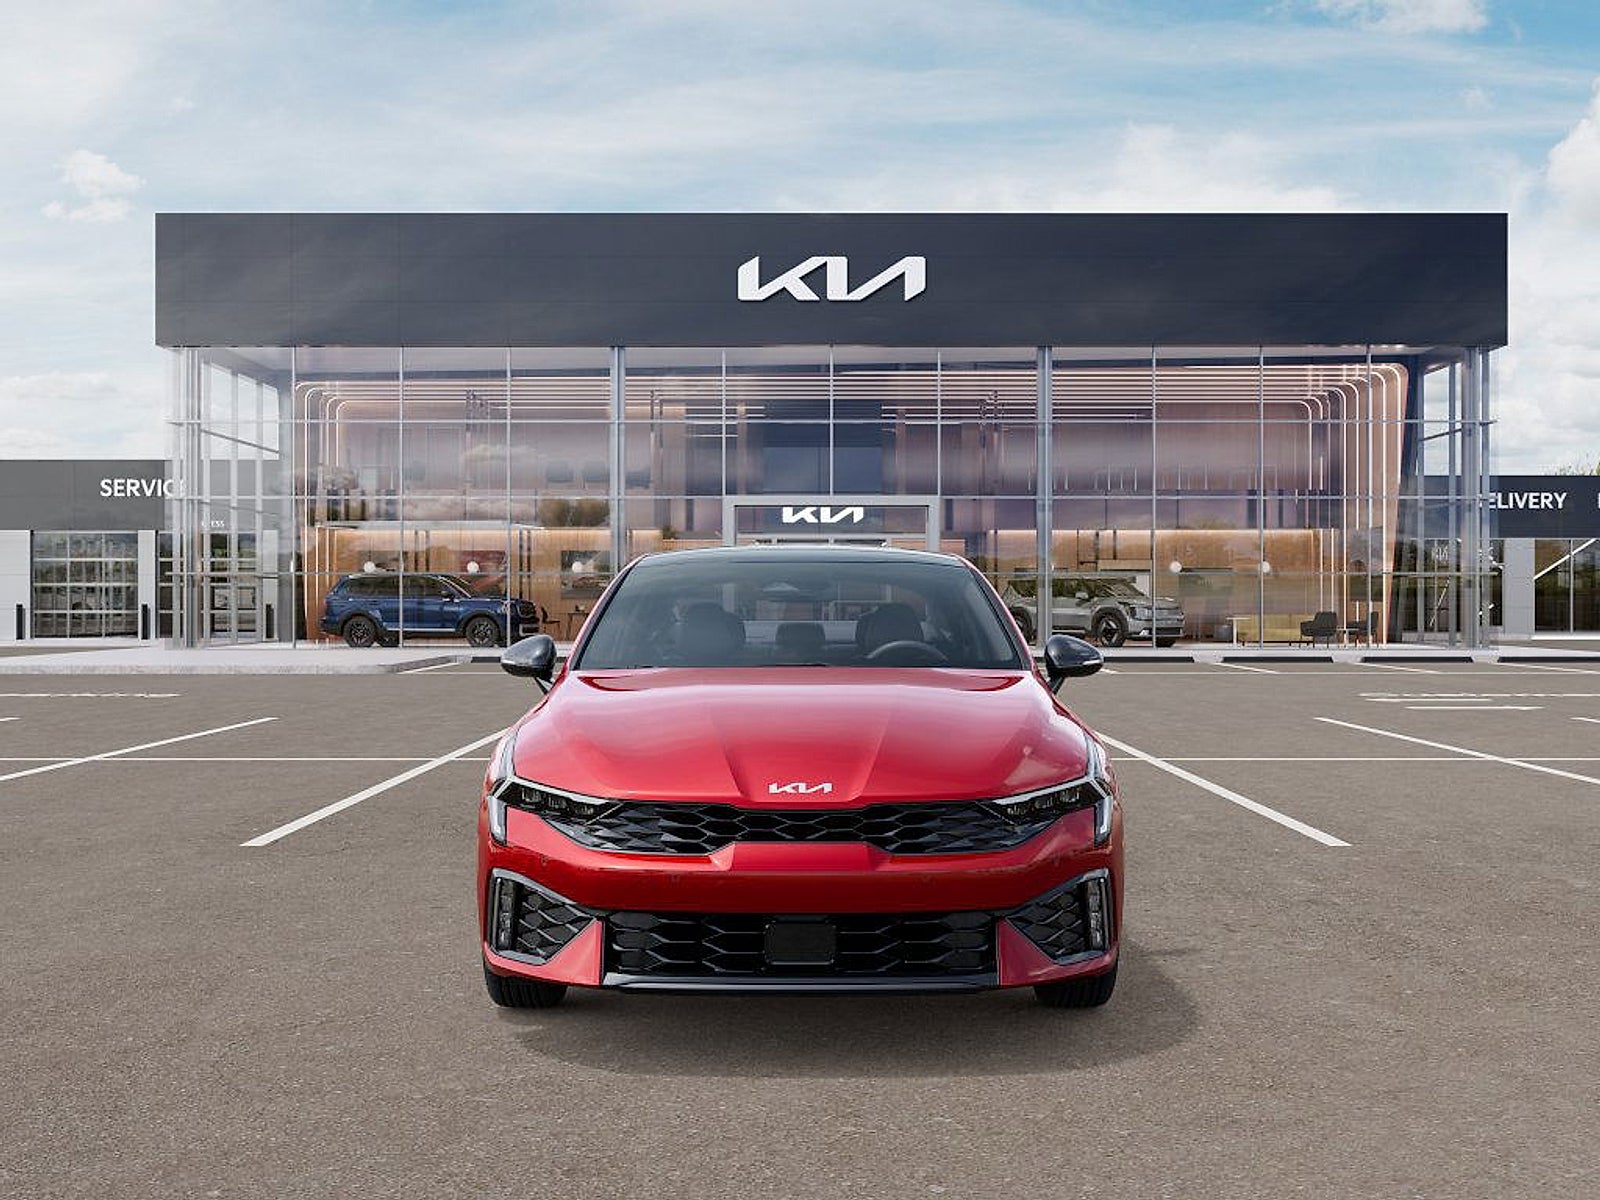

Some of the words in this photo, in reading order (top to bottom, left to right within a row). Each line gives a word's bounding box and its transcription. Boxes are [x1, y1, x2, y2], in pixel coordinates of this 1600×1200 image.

[737, 256, 926, 301] KIA
[99, 478, 187, 498] SERVIC
[1478, 492, 1567, 510] ELIVERY
[782, 506, 864, 524] KIA
[768, 782, 833, 794] KIA
